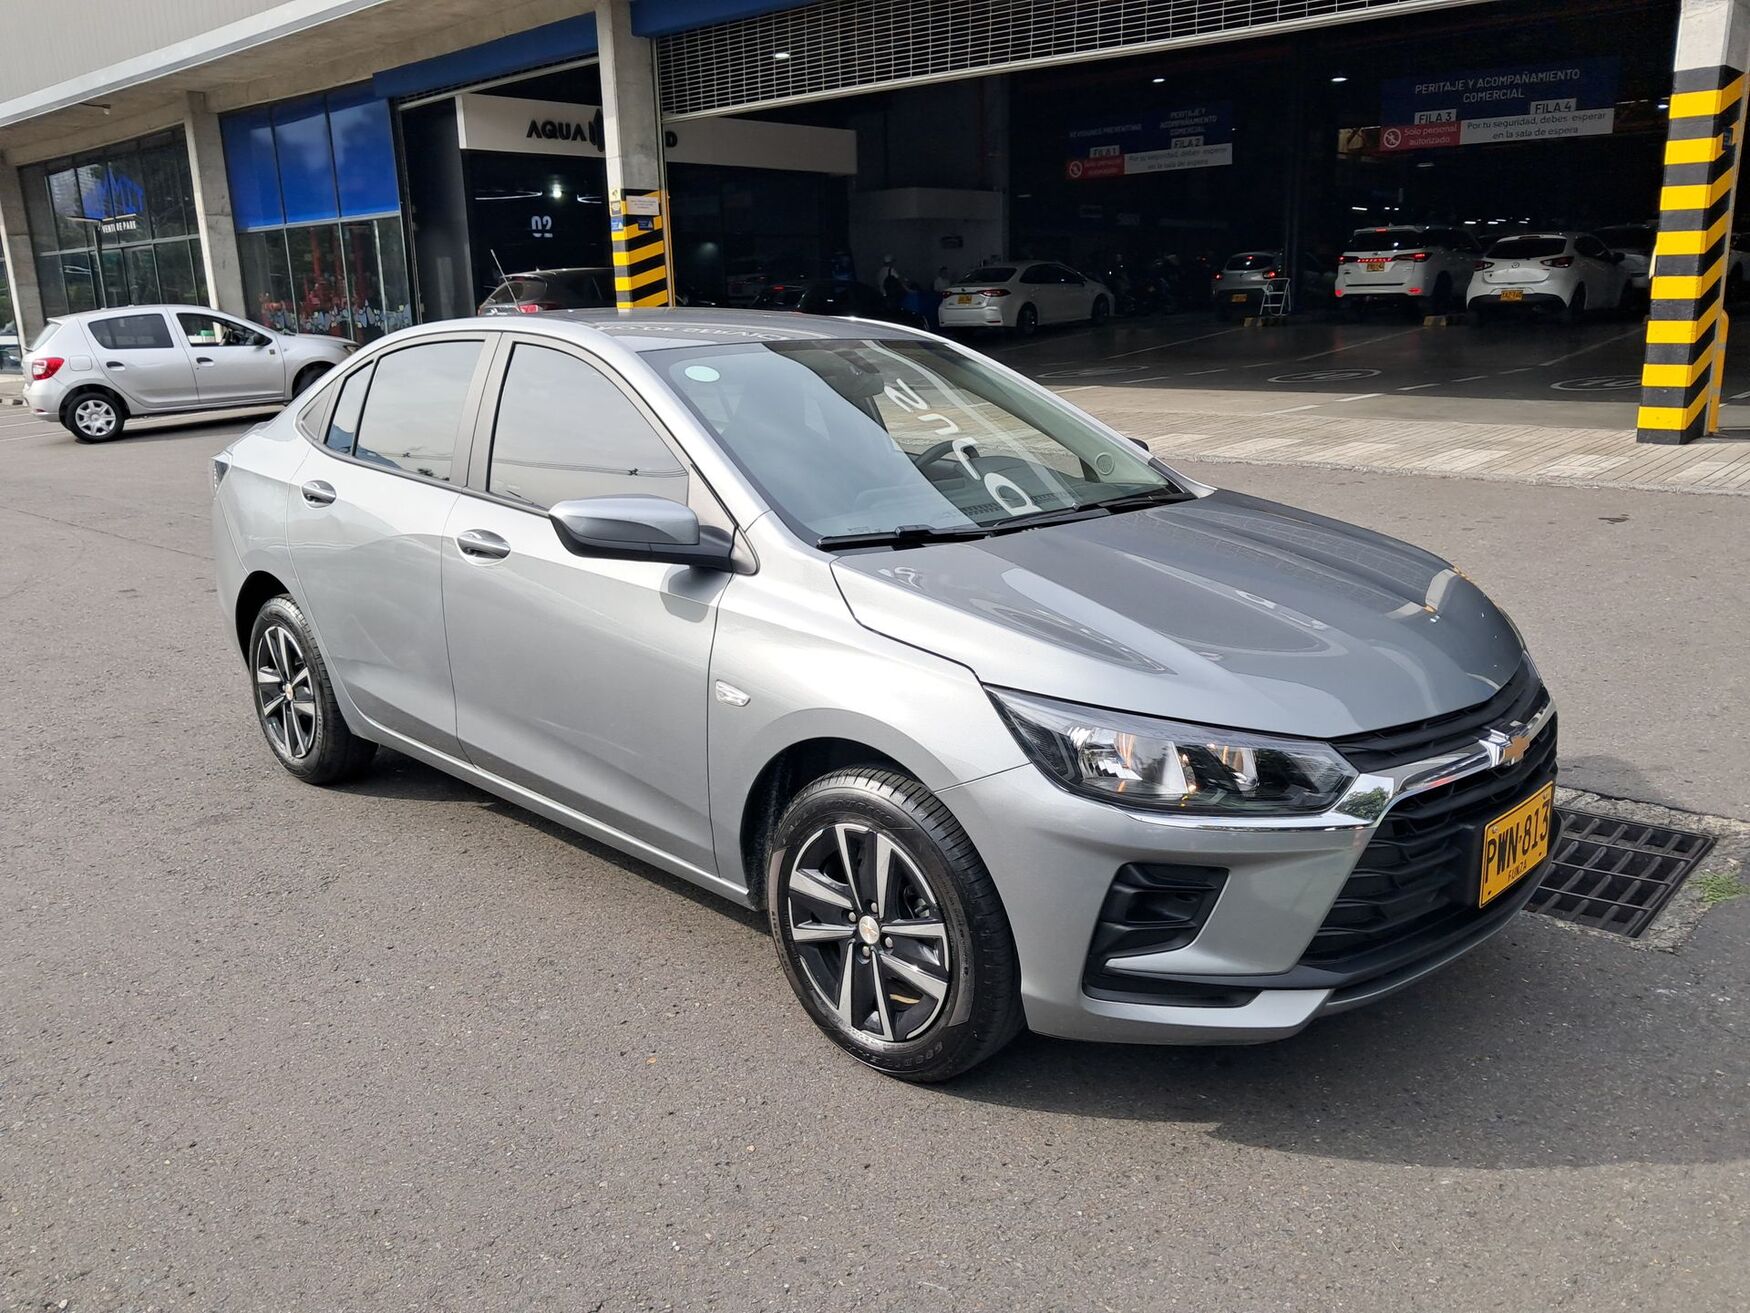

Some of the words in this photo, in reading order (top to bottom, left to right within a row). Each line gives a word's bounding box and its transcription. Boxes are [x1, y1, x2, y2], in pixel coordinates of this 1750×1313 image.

[1415, 80, 1464, 95] PERITAJE
[1468, 79, 1475, 89] Y
[1476, 69, 1580, 88] ACOMPAÑAMIENTO
[1463, 88, 1525, 103] COMERCIAL
[1535, 102, 1561, 114] FILA
[1564, 101, 1571, 112] 4
[1418, 112, 1442, 124] FILA
[1445, 111, 1452, 122] 3
[526, 119, 587, 142] AQUA
[1403, 127, 1420, 136] Solo
[1421, 124, 1458, 136] personal
[1467, 121, 1482, 130] Por
[1492, 131, 1504, 139] en
[1505, 129, 1514, 138] la
[1534, 127, 1546, 136] de
[1408, 135, 1451, 145] autorizado
[531, 215, 553, 238] 02
[1507, 859, 1528, 882] FUNZA
